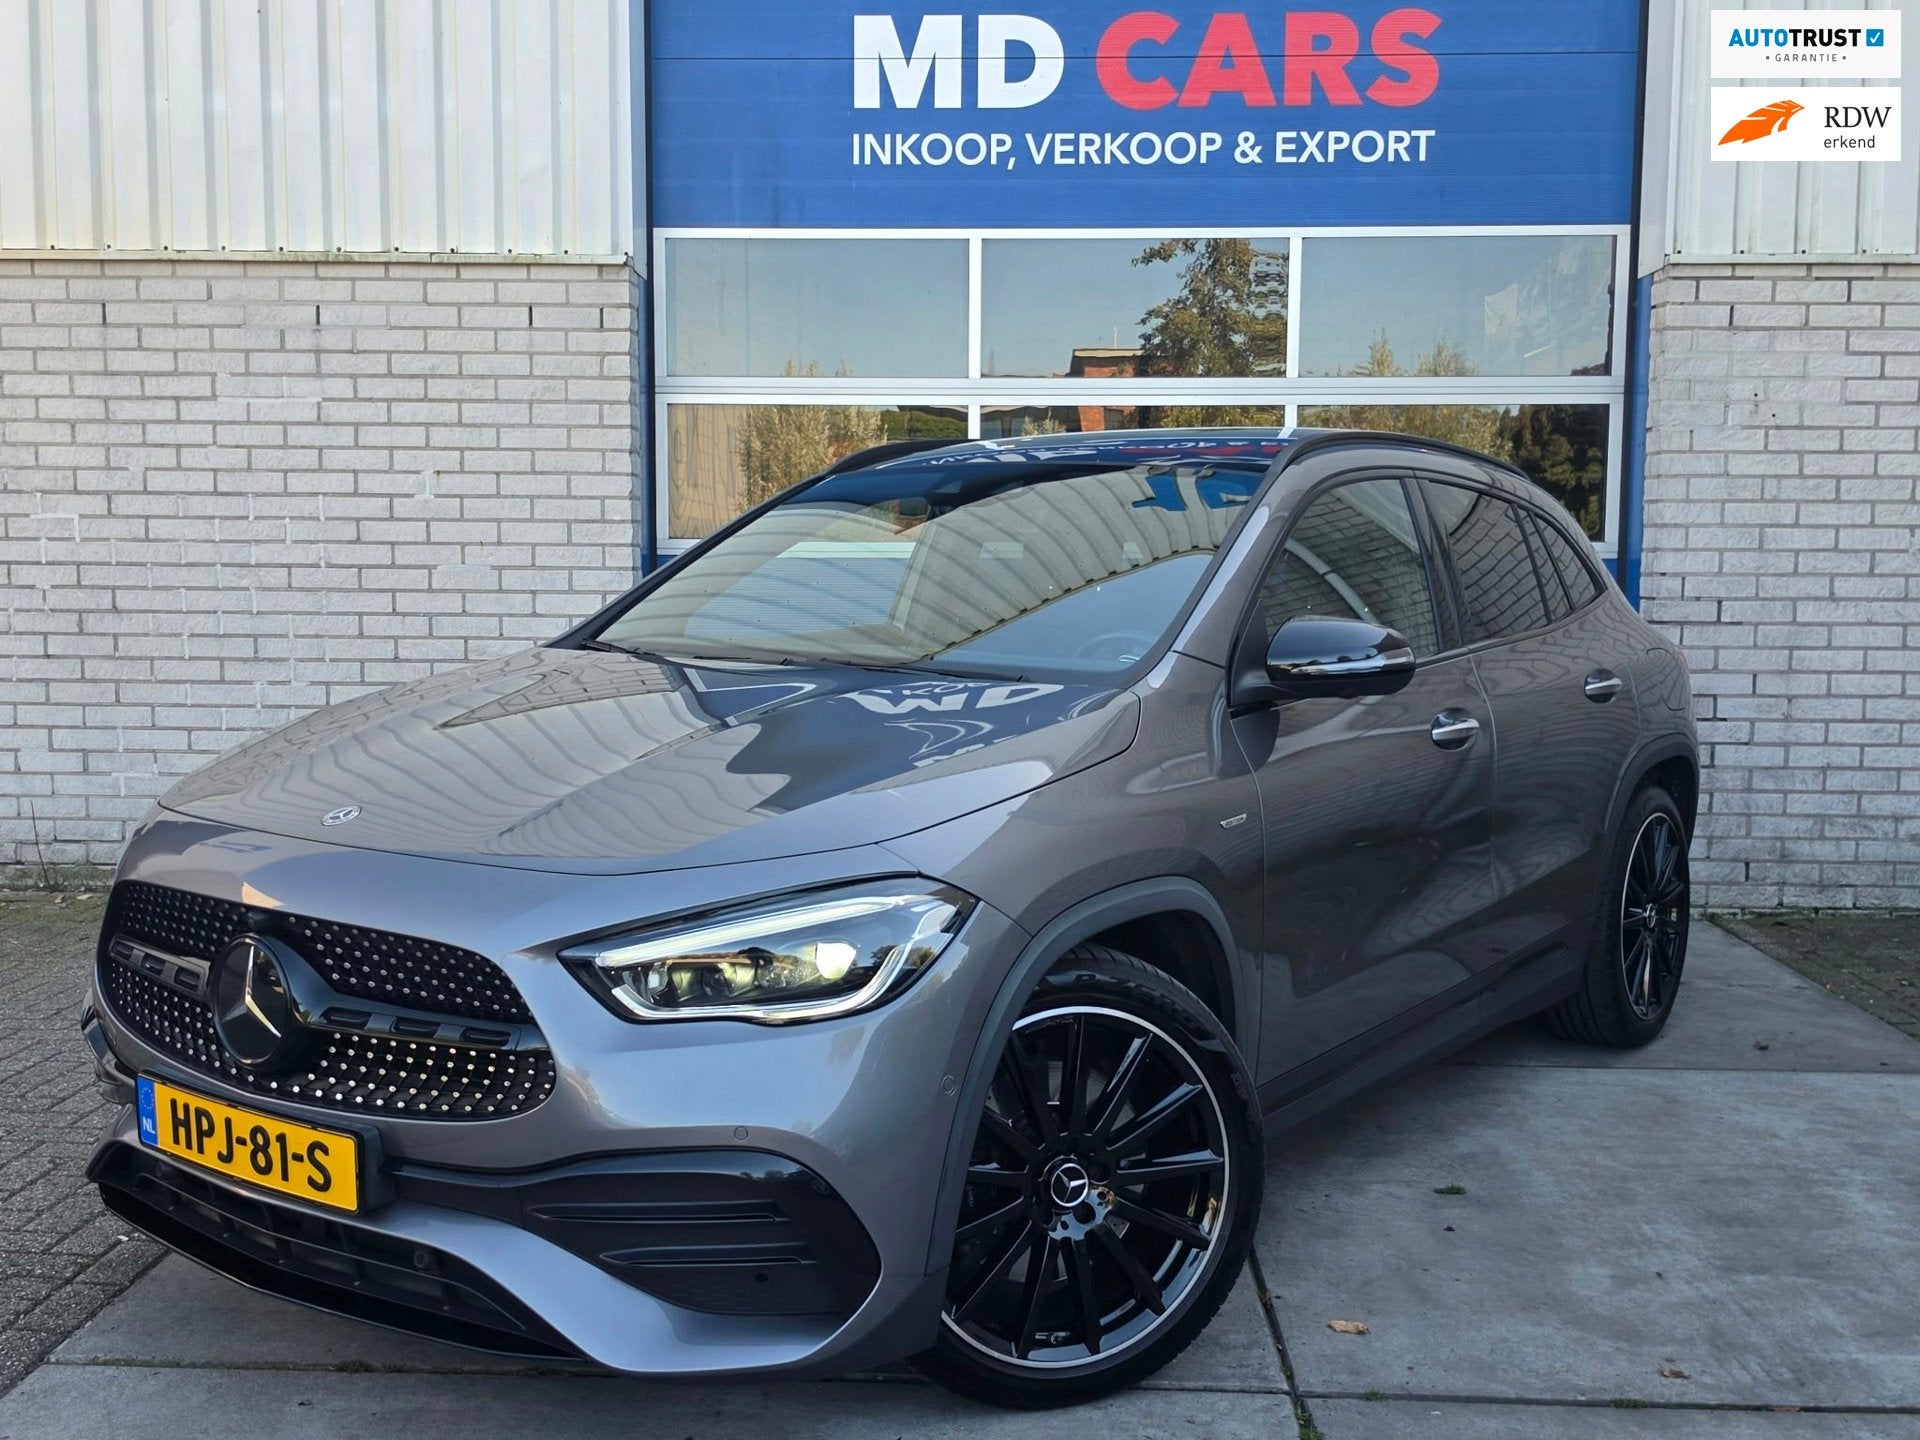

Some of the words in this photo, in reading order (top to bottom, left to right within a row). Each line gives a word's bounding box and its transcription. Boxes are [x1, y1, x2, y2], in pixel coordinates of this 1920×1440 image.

[852, 14, 1065, 109] MD
[1095, 8, 1443, 111] CARS
[852, 132, 1015, 170] INKOOP,
[1025, 131, 1223, 165] VERKOOP
[1233, 131, 1263, 163] &
[1275, 130, 1435, 163] EXPORT
[142, 1116, 156, 1134] NL
[170, 1097, 332, 1192] HPJ-81-S
